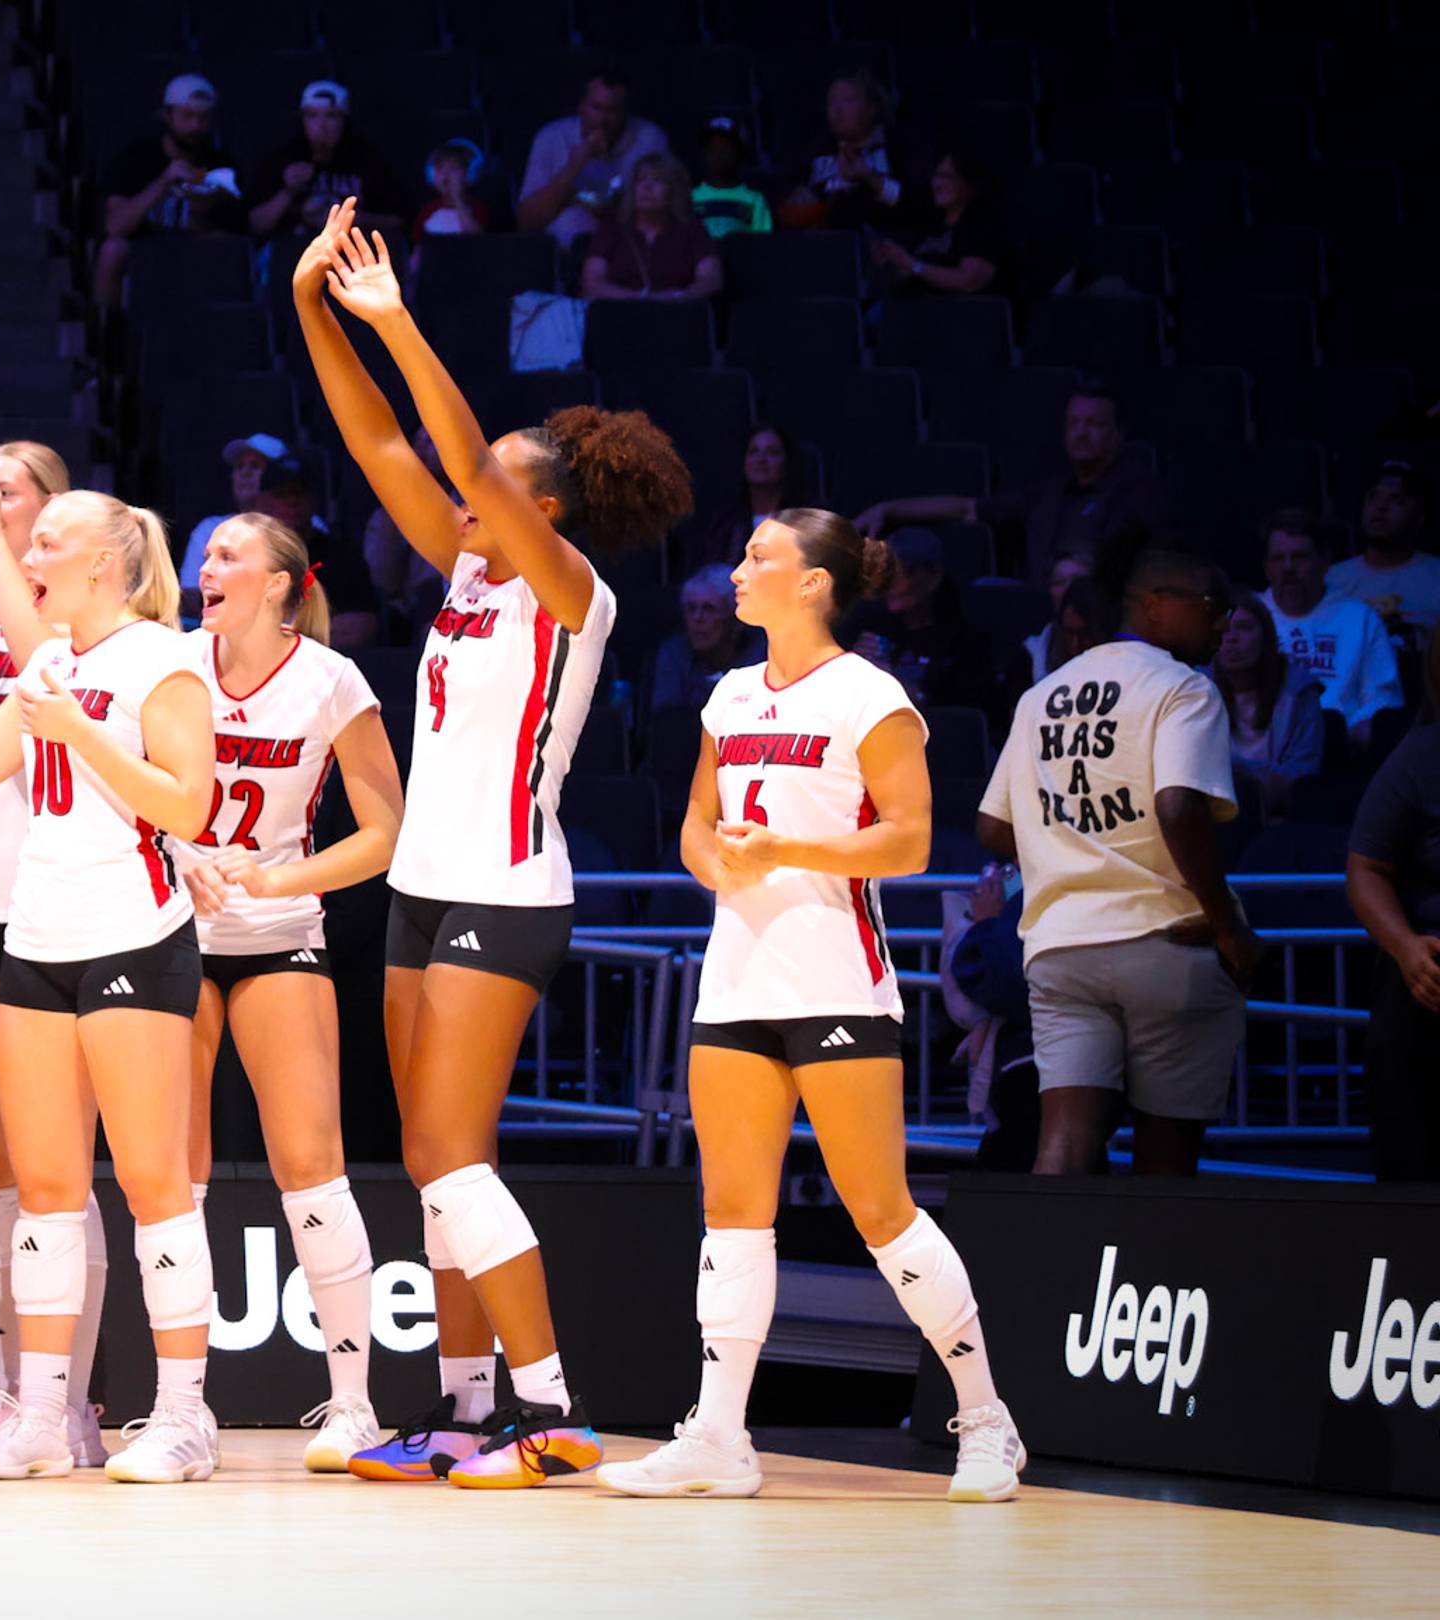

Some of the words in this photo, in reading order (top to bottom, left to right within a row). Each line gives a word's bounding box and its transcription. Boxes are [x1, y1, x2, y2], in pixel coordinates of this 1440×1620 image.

[1046, 681, 1121, 718] GOD
[215, 733, 307, 770] ISVILLE
[1040, 720, 1118, 761] HAS
[32, 736, 75, 817] 10
[1068, 759, 1091, 795] A
[1038, 787, 1145, 834] PLAN.
[1065, 1245, 1209, 1415] Jeep
[1329, 1257, 1440, 1409] Jee
